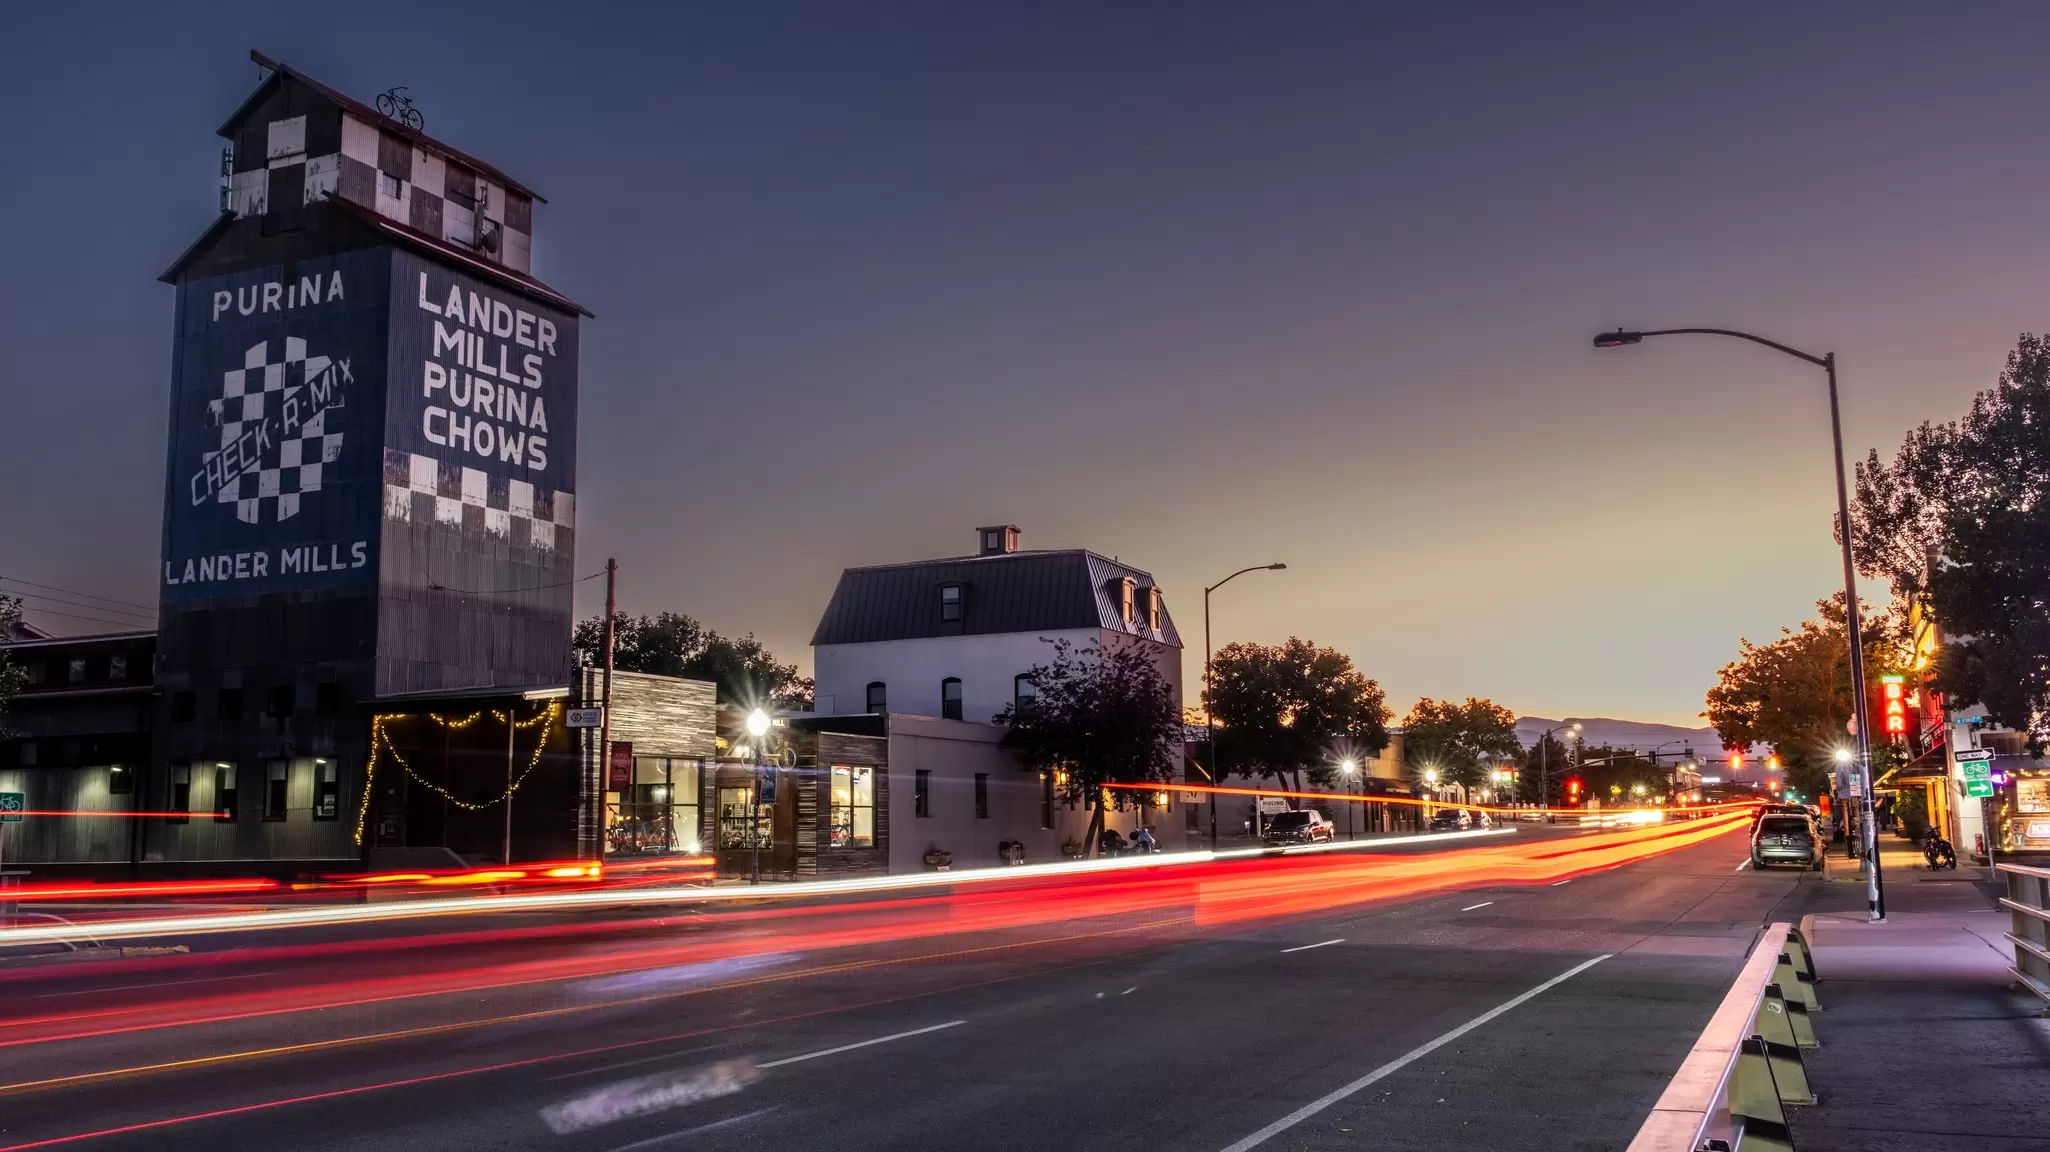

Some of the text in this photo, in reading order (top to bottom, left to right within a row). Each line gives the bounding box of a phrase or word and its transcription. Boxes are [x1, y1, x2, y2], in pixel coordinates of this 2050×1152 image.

[212, 270, 345, 322] PURINA
[417, 271, 558, 356] LANDER
[433, 320, 544, 390] MILLS
[423, 361, 549, 434] PURINA
[422, 405, 549, 472] CHOWS
[165, 541, 368, 585] LANDER MILLS
[1887, 682, 1903, 731] BAR
